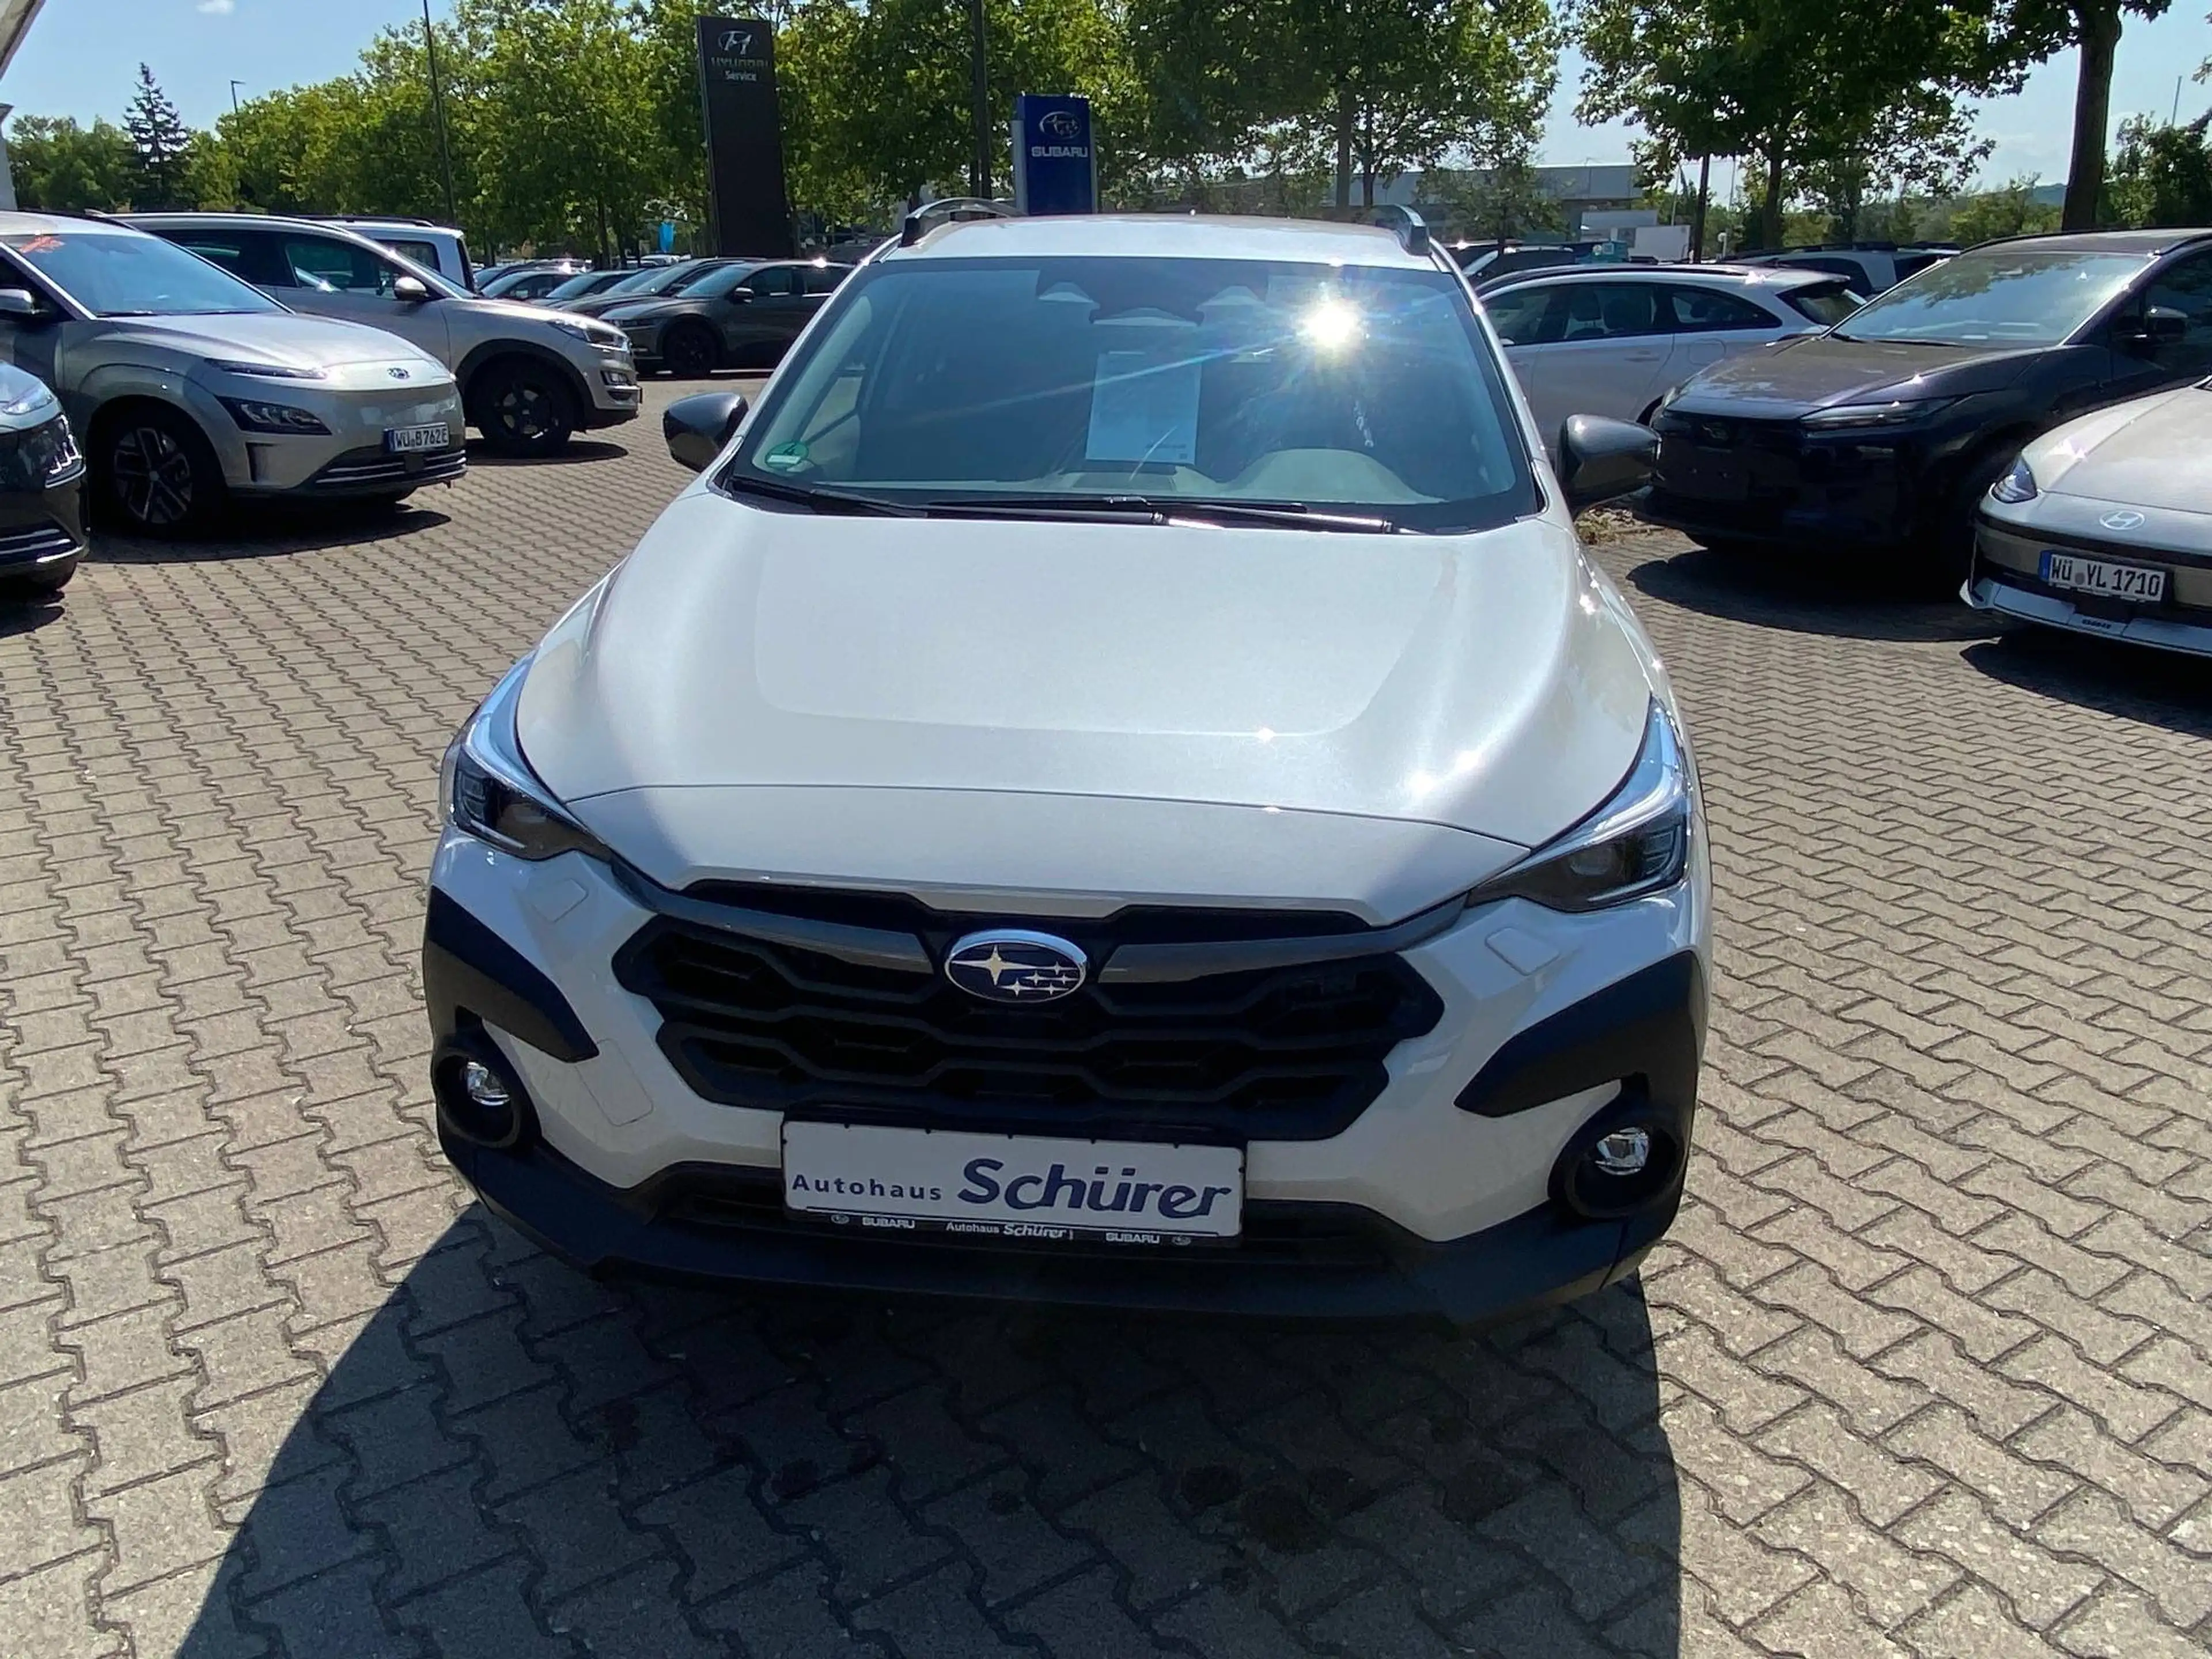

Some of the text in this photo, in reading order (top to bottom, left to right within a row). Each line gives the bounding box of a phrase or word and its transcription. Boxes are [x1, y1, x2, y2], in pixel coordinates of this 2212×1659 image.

[1031, 146, 1088, 157] SUBARU
[2052, 557, 2160, 597] WÜ YL 1710
[792, 1158, 1232, 1219] Autohaus Schürer
[862, 1217, 915, 1229] SUBARU
[946, 1222, 1066, 1239] Autohaus Schürer
[1105, 1232, 1160, 1244] SUBARU
